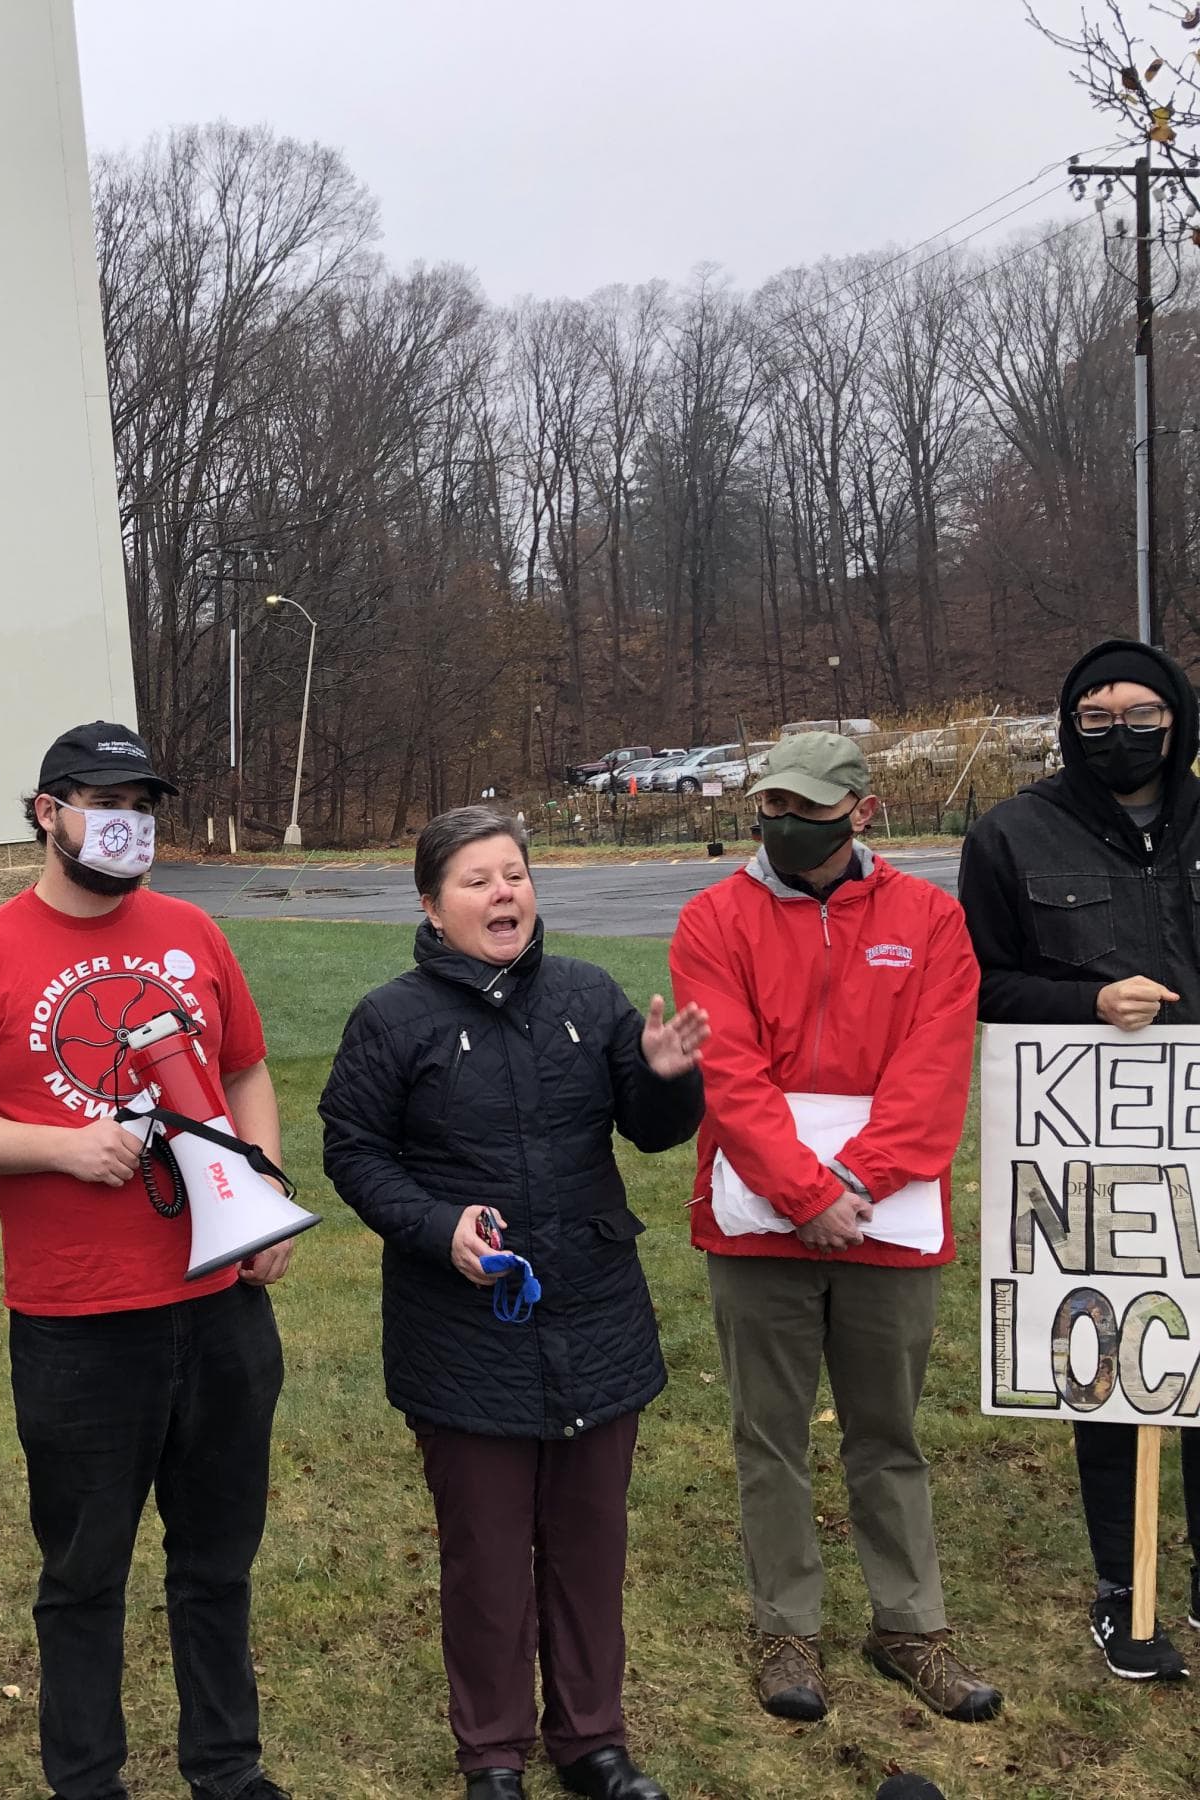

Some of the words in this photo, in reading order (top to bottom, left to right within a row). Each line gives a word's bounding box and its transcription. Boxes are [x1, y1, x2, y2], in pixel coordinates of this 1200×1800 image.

[29, 955, 111, 1053] PIONEER
[122, 954, 208, 1028] VALLEY
[42, 1070, 122, 1121] NEW
[208, 1161, 234, 1200] PYLE
